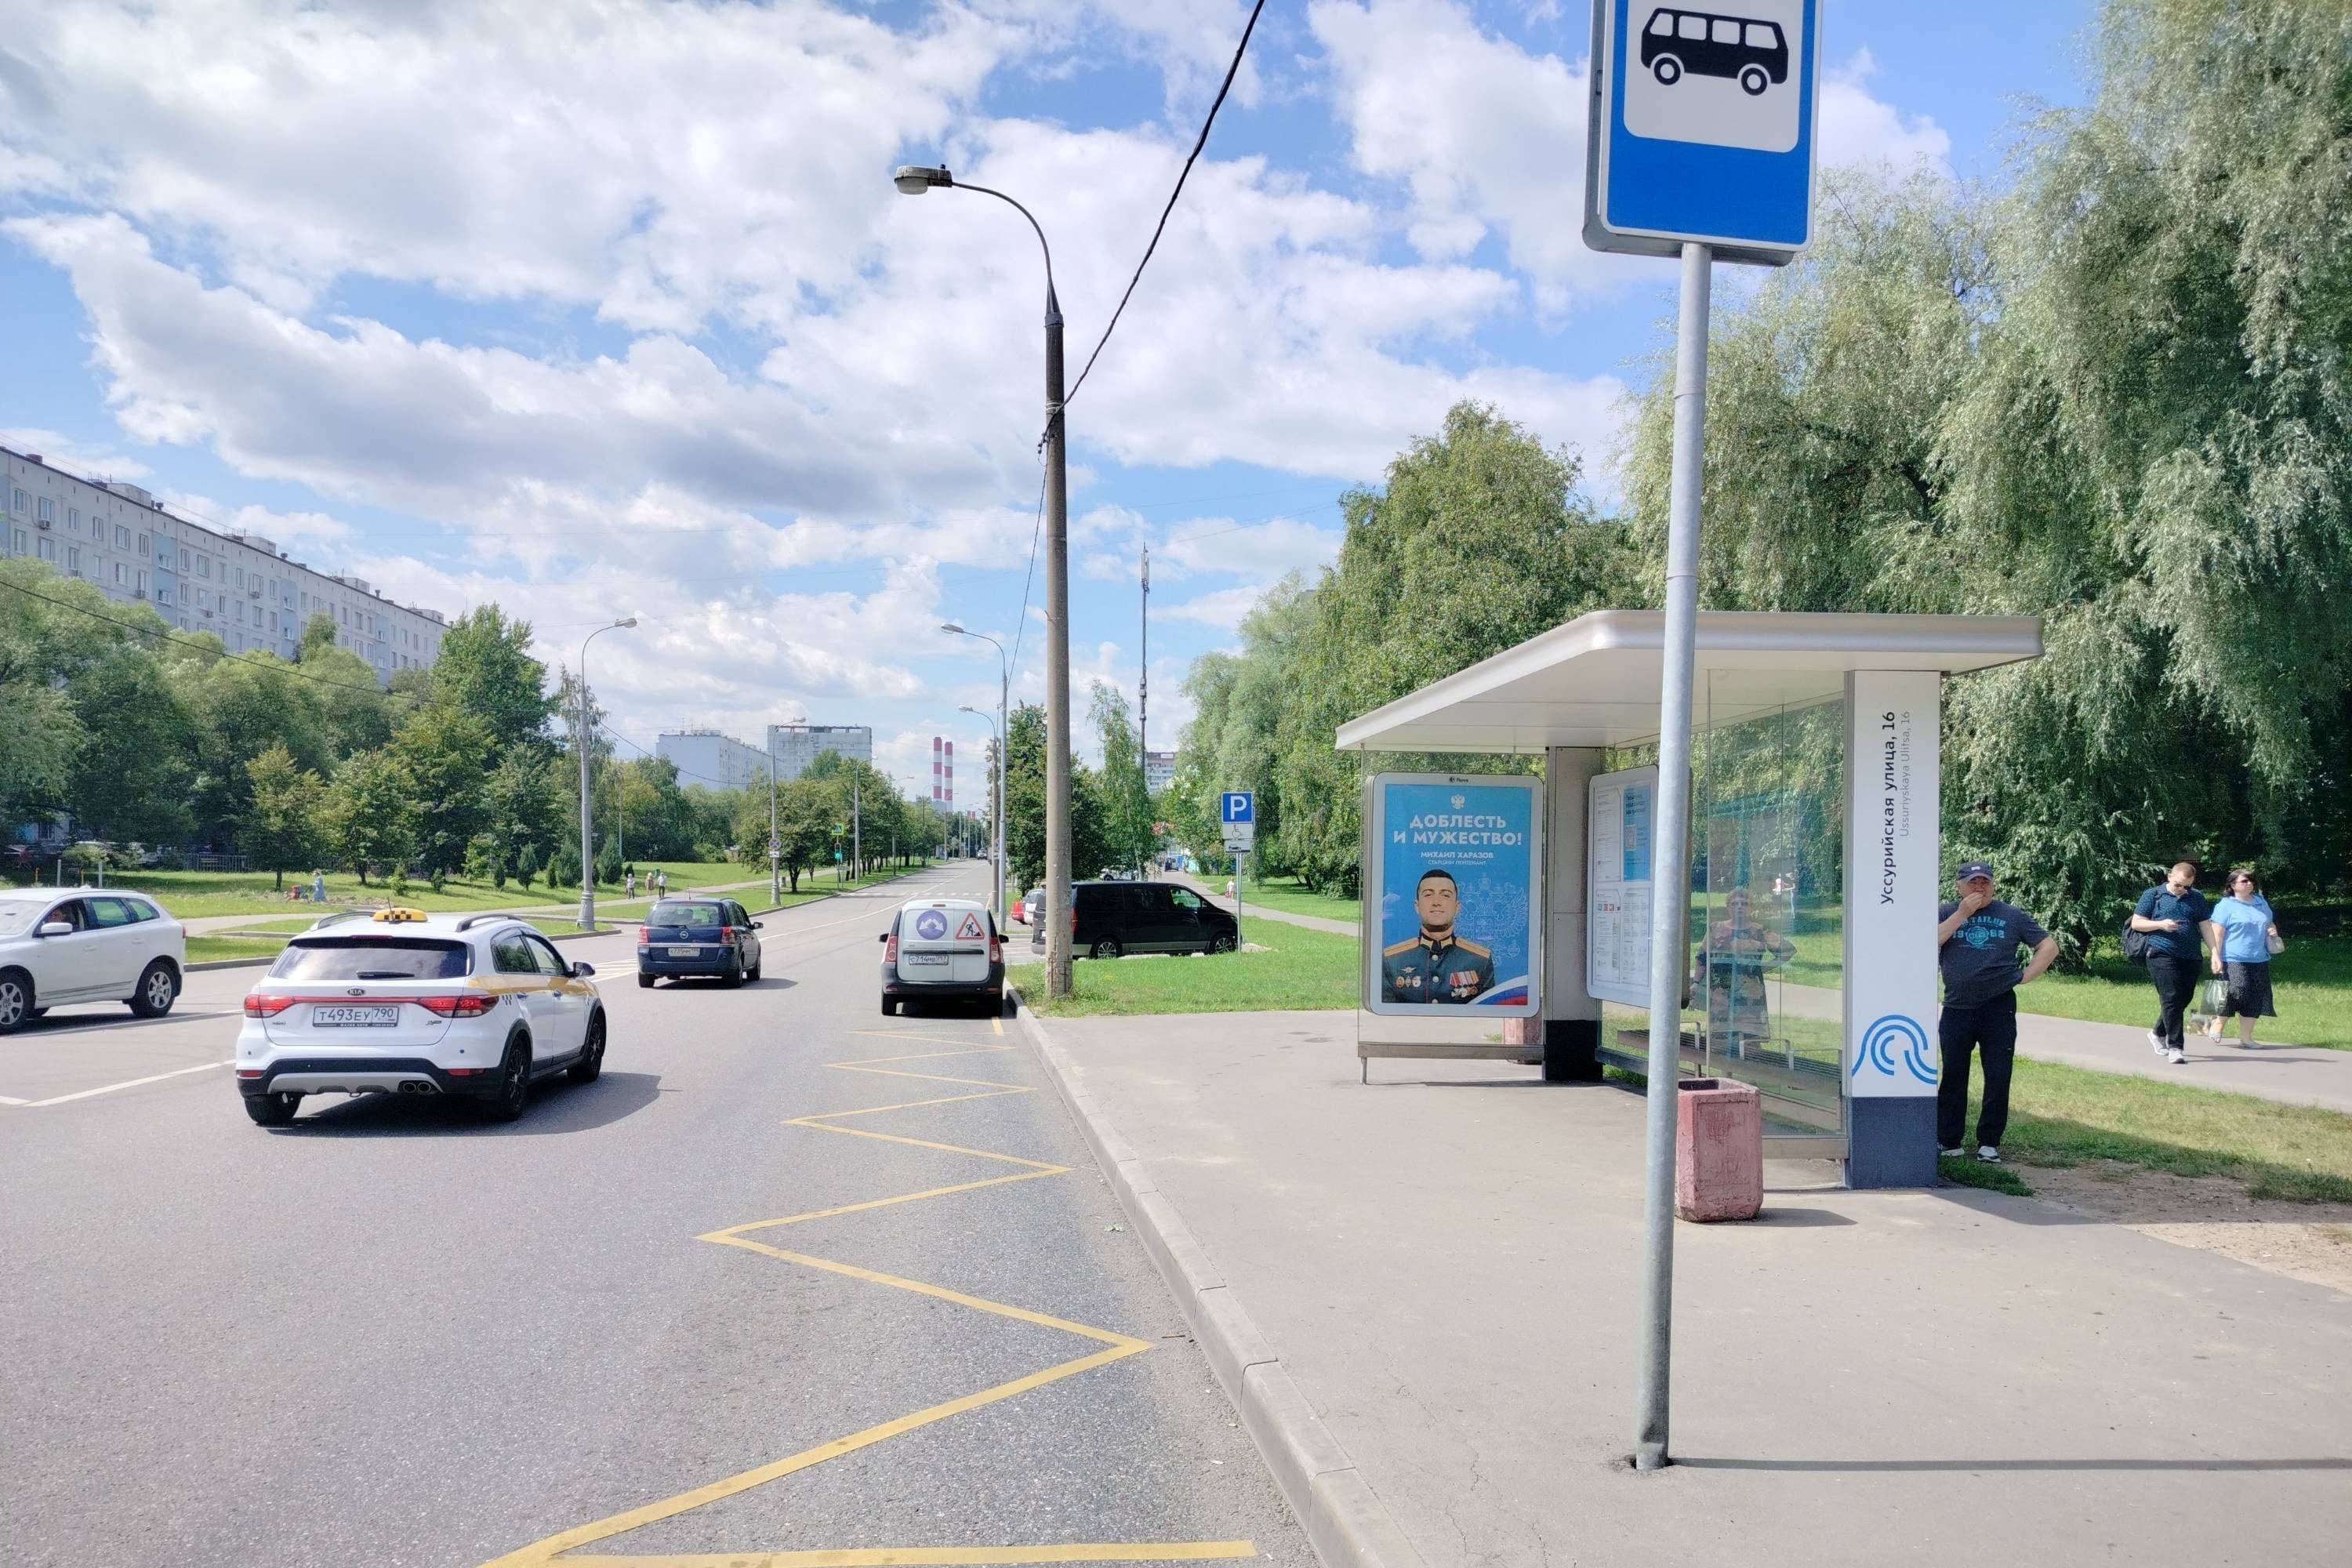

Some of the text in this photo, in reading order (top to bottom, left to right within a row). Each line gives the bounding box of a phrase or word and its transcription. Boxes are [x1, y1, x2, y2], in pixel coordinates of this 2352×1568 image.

[1900, 711, 1911, 837] Ussuriyskaya Ulitsa, 16
[1230, 795, 1247, 820] P
[1881, 711, 1898, 905] Уссурийская улица, 16
[1410, 815, 1507, 829] ДОБЛЕСТЬ
[1393, 830, 1522, 846] И МУЖЕСТВО!
[374, 1008, 394, 1018] 790
